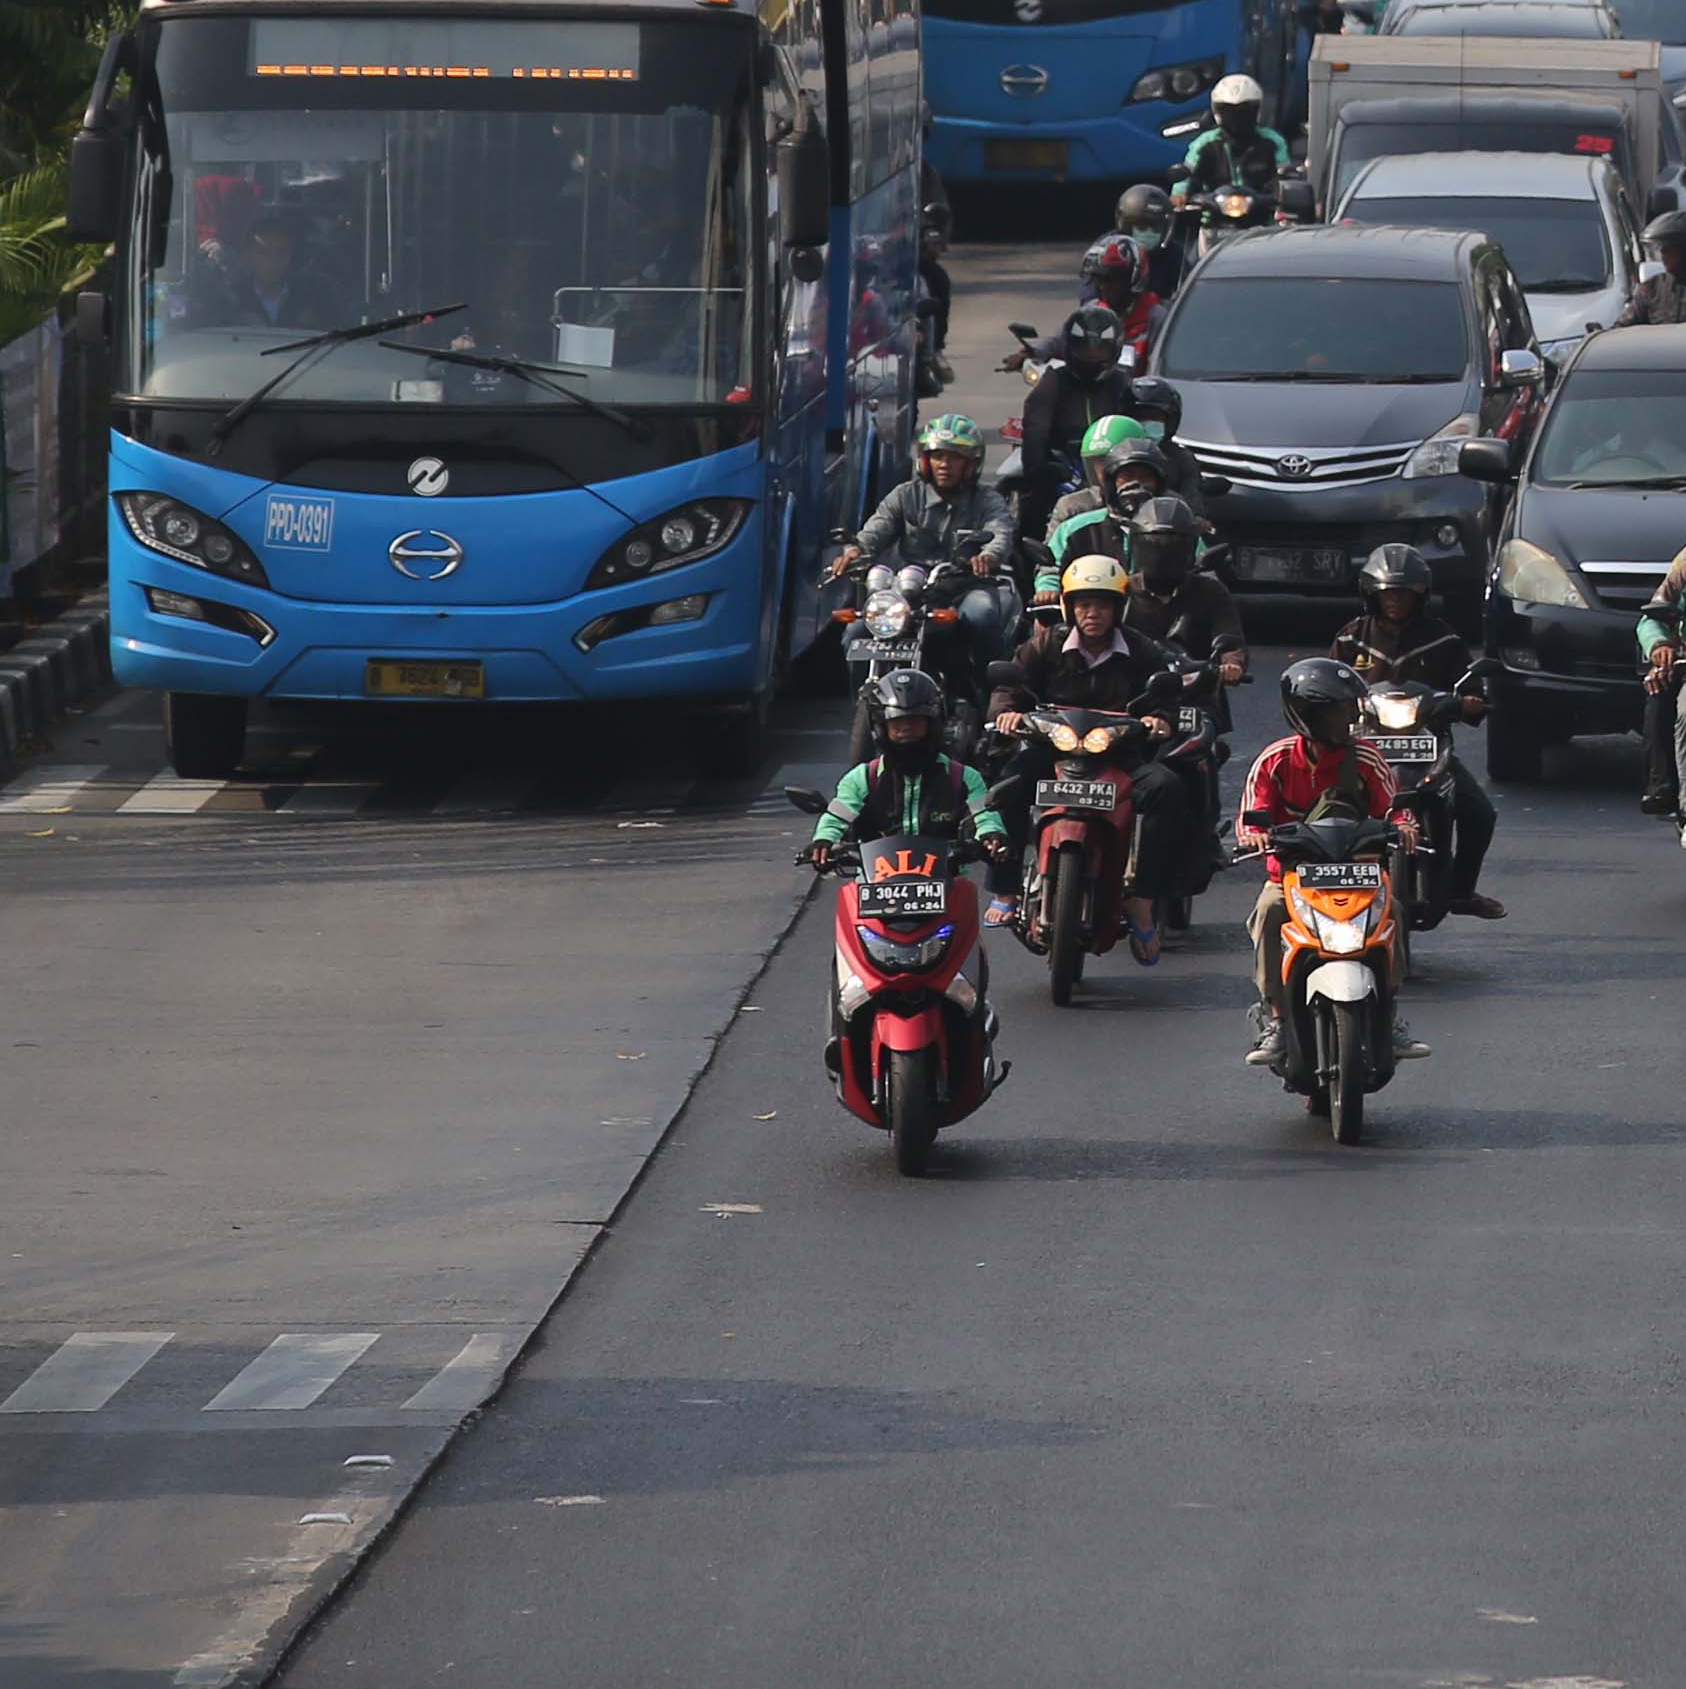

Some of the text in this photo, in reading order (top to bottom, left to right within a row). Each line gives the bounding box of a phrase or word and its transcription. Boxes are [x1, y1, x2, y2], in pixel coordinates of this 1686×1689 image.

[267, 501, 330, 544] PPD-0391
[1039, 782, 1113, 797] B 6432 PKA
[870, 849, 938, 883] ALI
[861, 884, 941, 901] B 3044 PHJ
